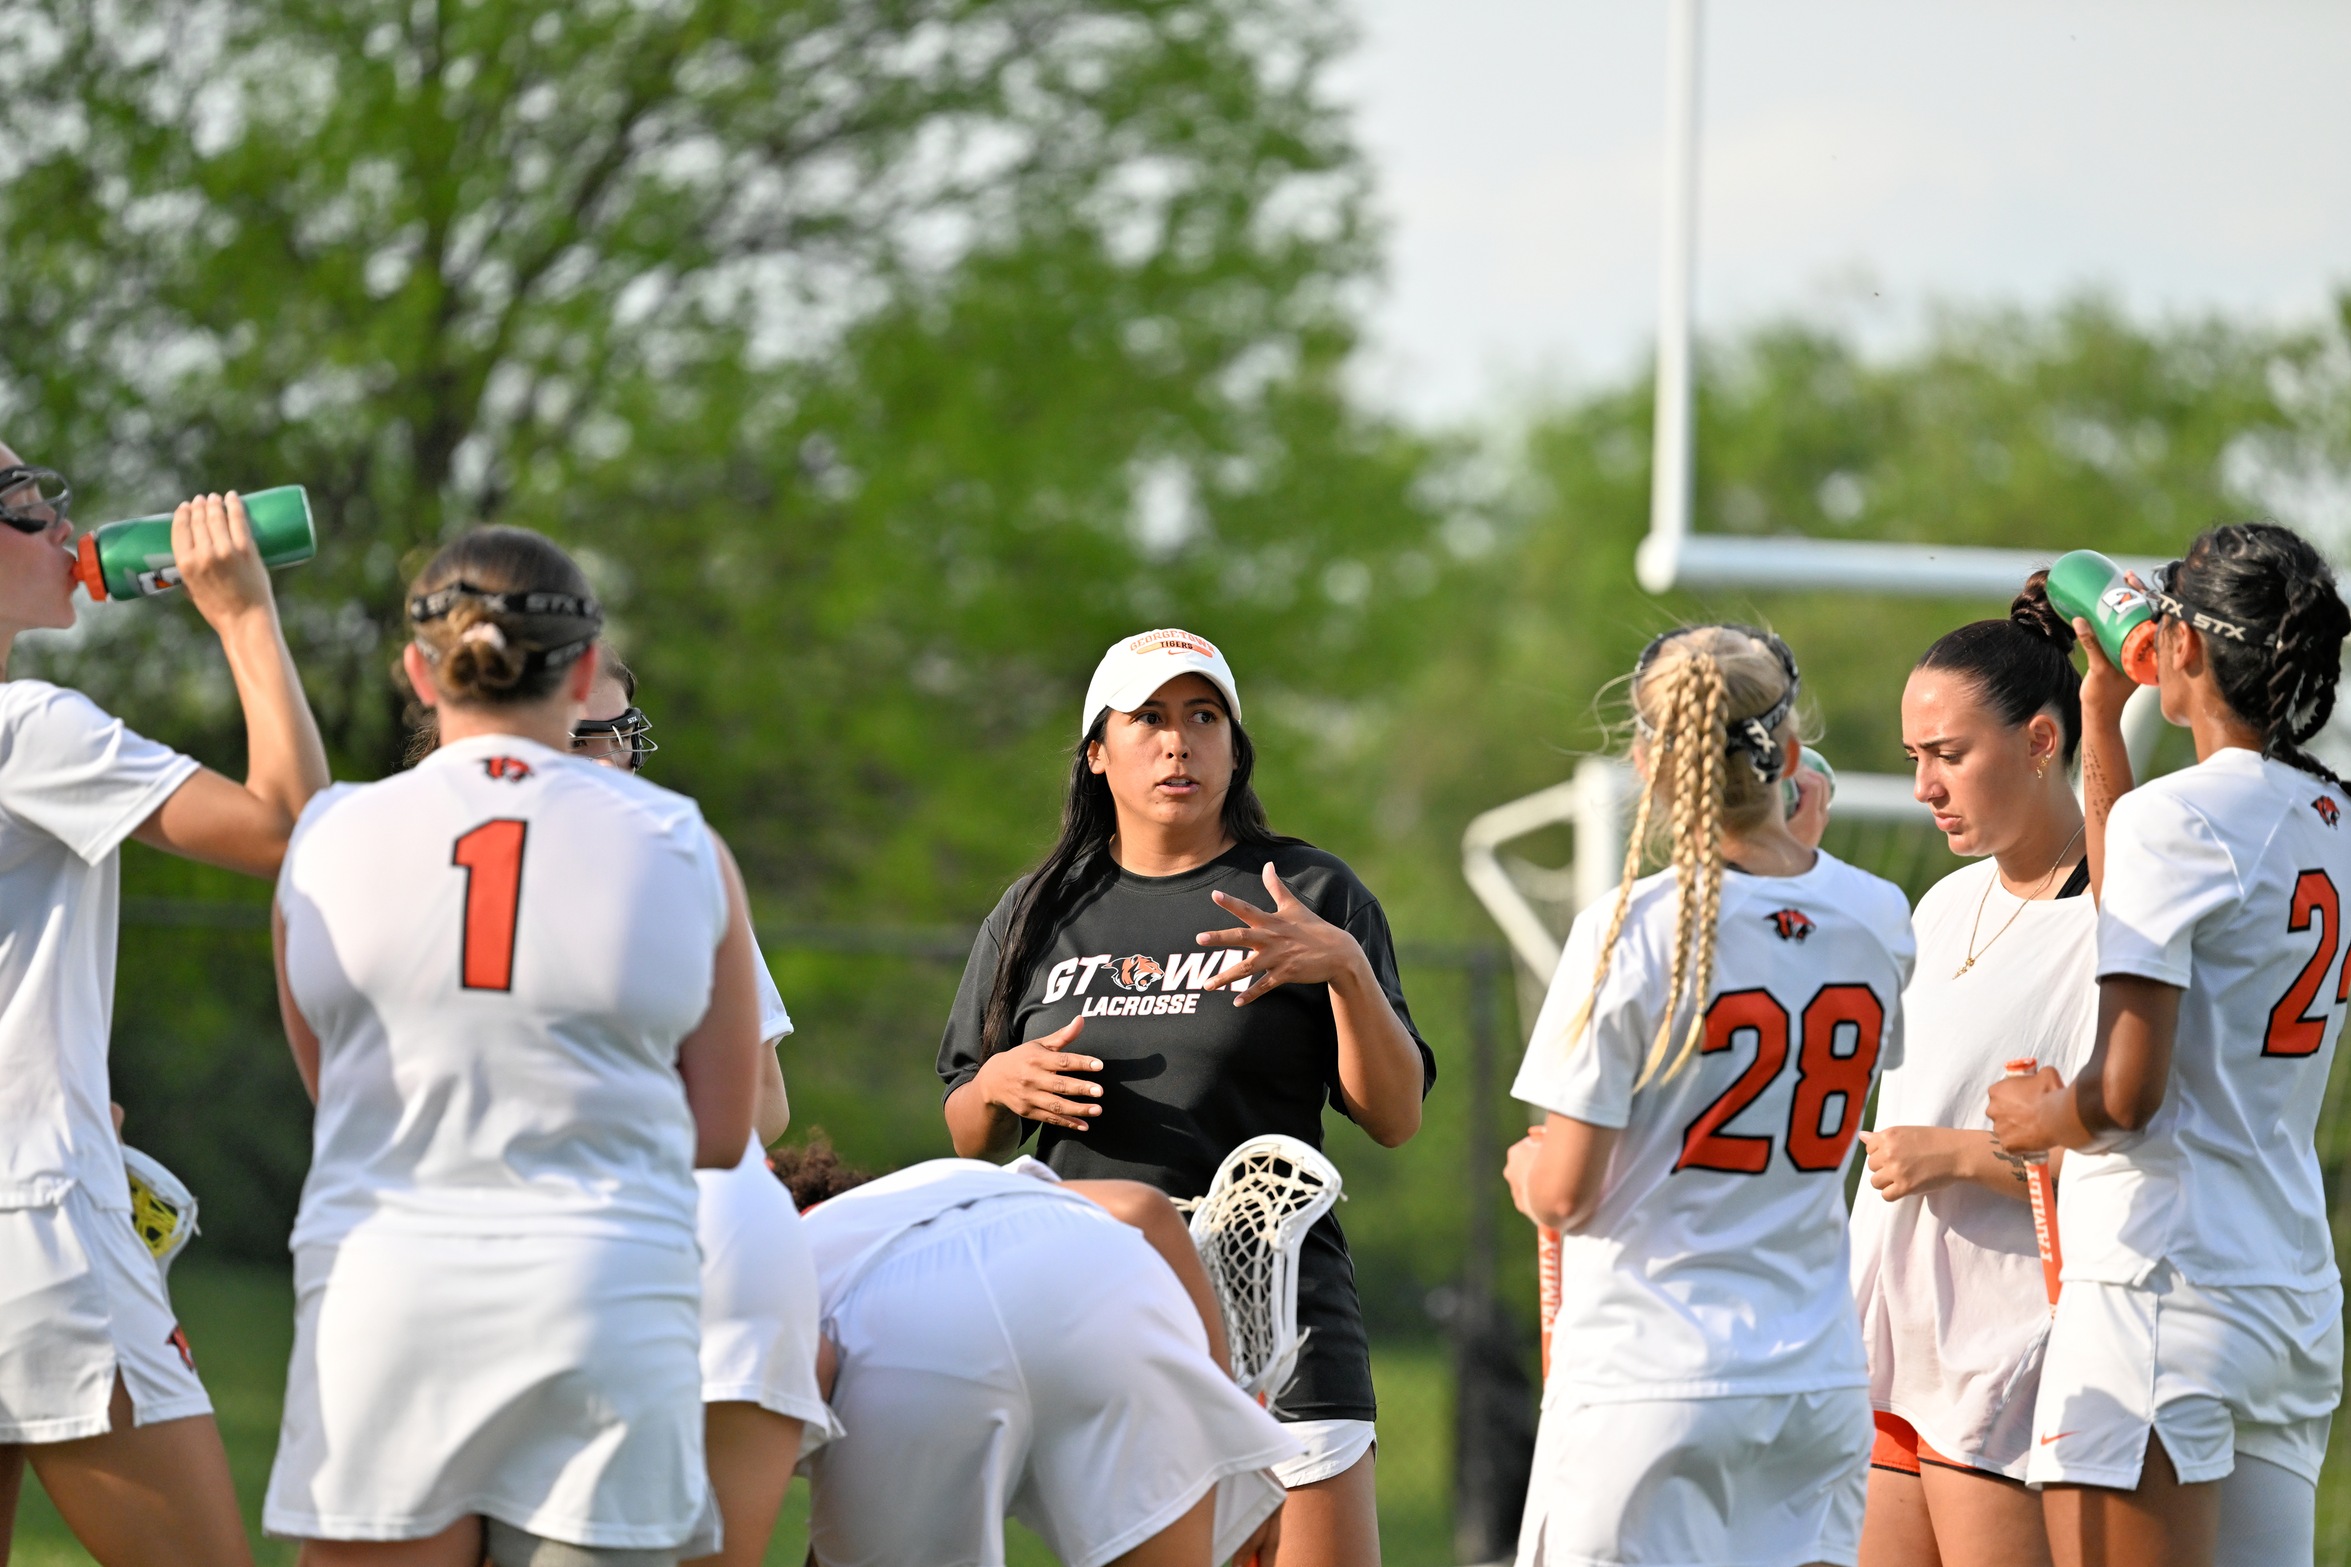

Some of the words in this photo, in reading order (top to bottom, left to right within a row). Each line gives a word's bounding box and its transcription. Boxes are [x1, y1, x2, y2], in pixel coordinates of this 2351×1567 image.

[1130, 630, 1216, 654] GEORGETOWN
[1160, 640, 1194, 650] TIGERS
[2158, 593, 2183, 619] TX
[2193, 612, 2246, 642] STX
[452, 816, 529, 992] 1
[2260, 868, 2351, 1058] 2
[1081, 993, 1200, 1018] LACROSSE
[1670, 982, 1885, 1176] 28
[2027, 1167, 2053, 1262] FAMILY
